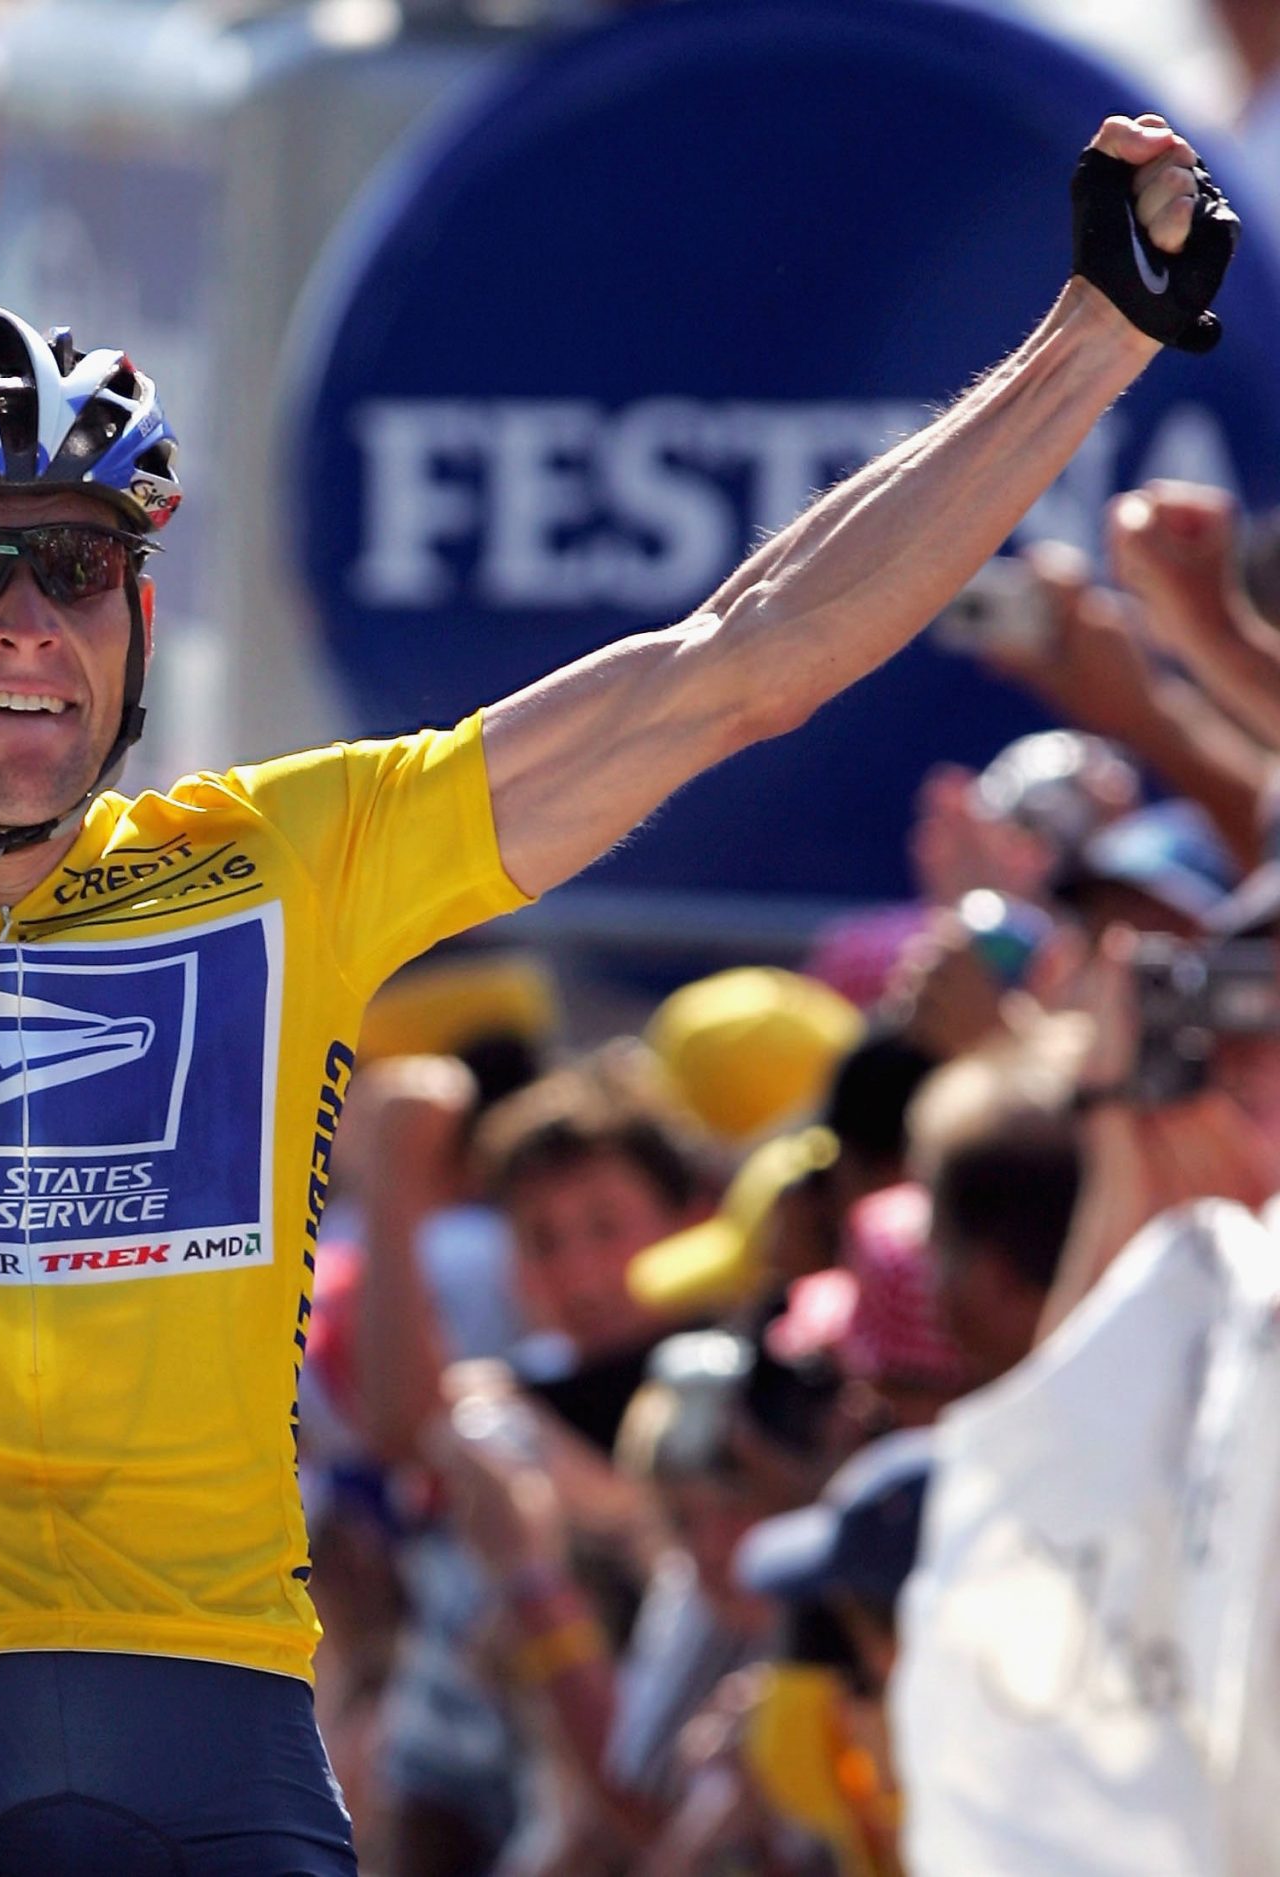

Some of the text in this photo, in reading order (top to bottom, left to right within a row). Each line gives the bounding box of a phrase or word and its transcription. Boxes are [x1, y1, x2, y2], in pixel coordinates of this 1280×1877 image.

[130, 479, 169, 507] Giro
[54, 841, 192, 905] CREDIT
[4, 1162, 153, 1194] STATES
[39, 1243, 171, 1273] TREK
[183, 1238, 243, 1262] AMD
